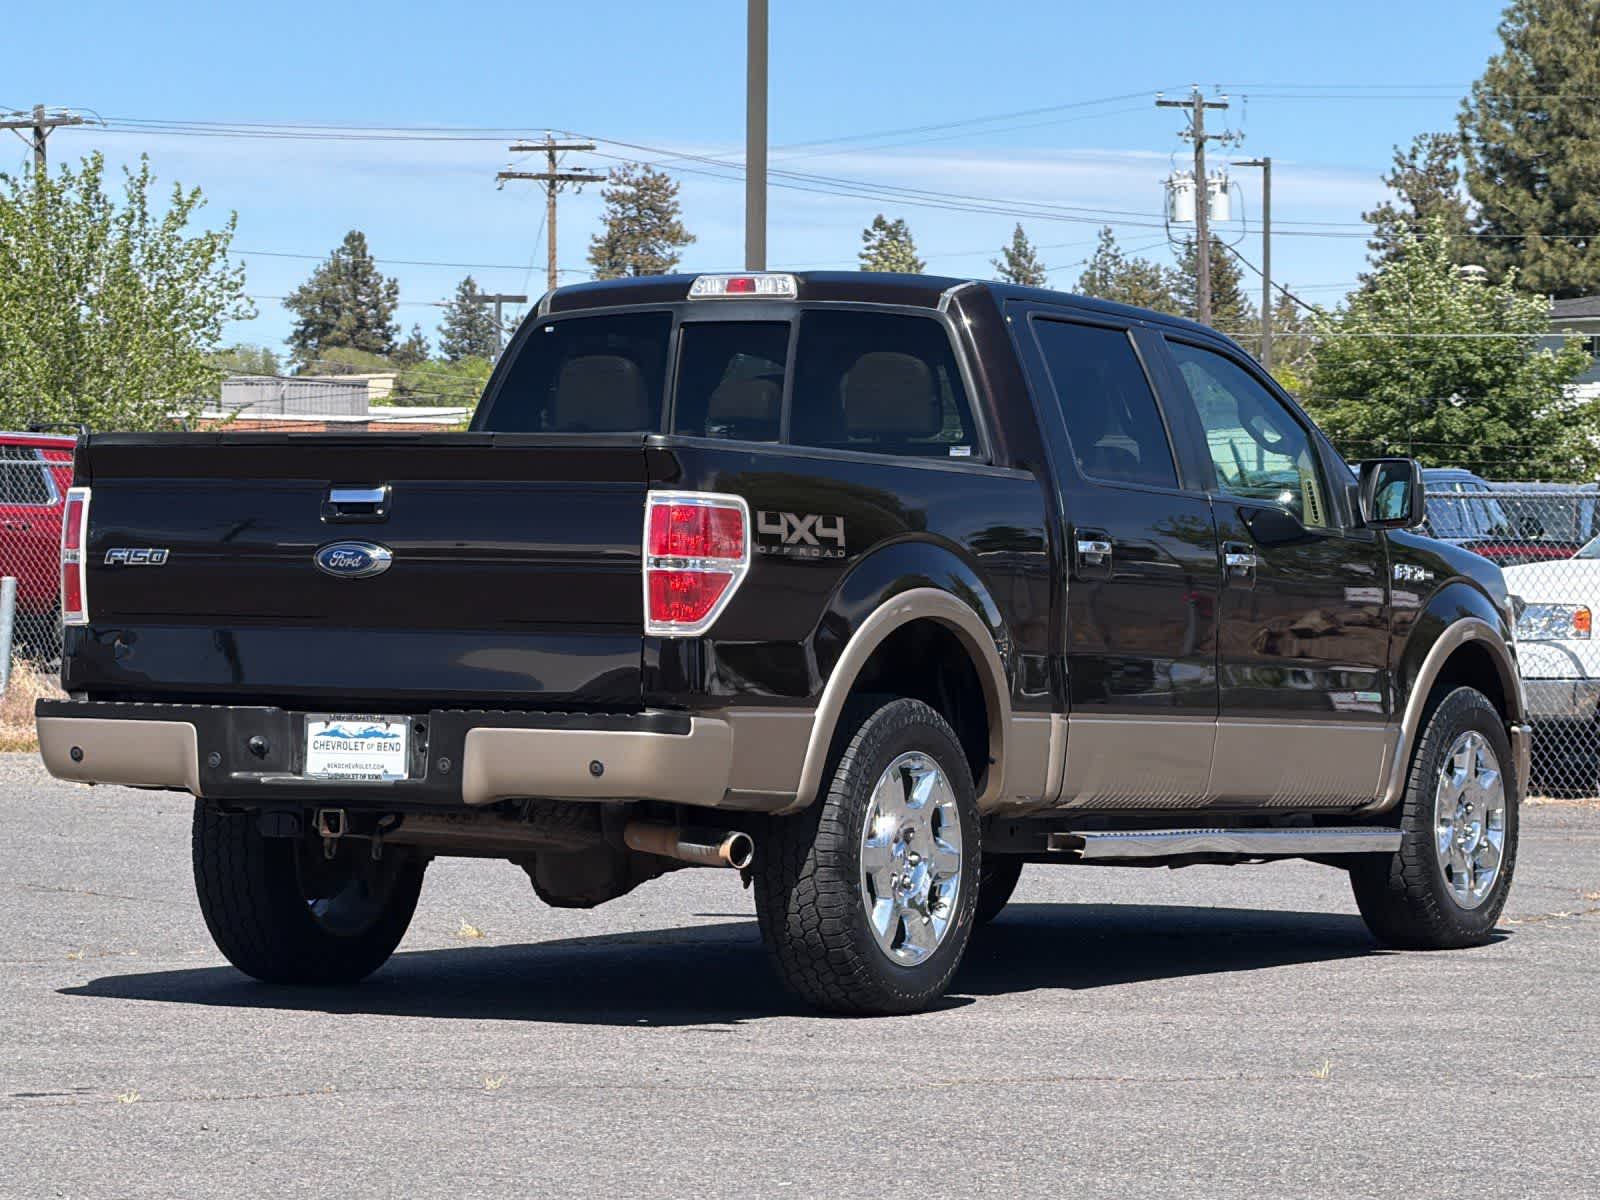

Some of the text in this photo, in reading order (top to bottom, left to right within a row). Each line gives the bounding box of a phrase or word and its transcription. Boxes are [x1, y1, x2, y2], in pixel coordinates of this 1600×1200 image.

[329, 550, 362, 568] Ford
[312, 740, 366, 751] CHEVROLET
[376, 741, 401, 752] BEND
